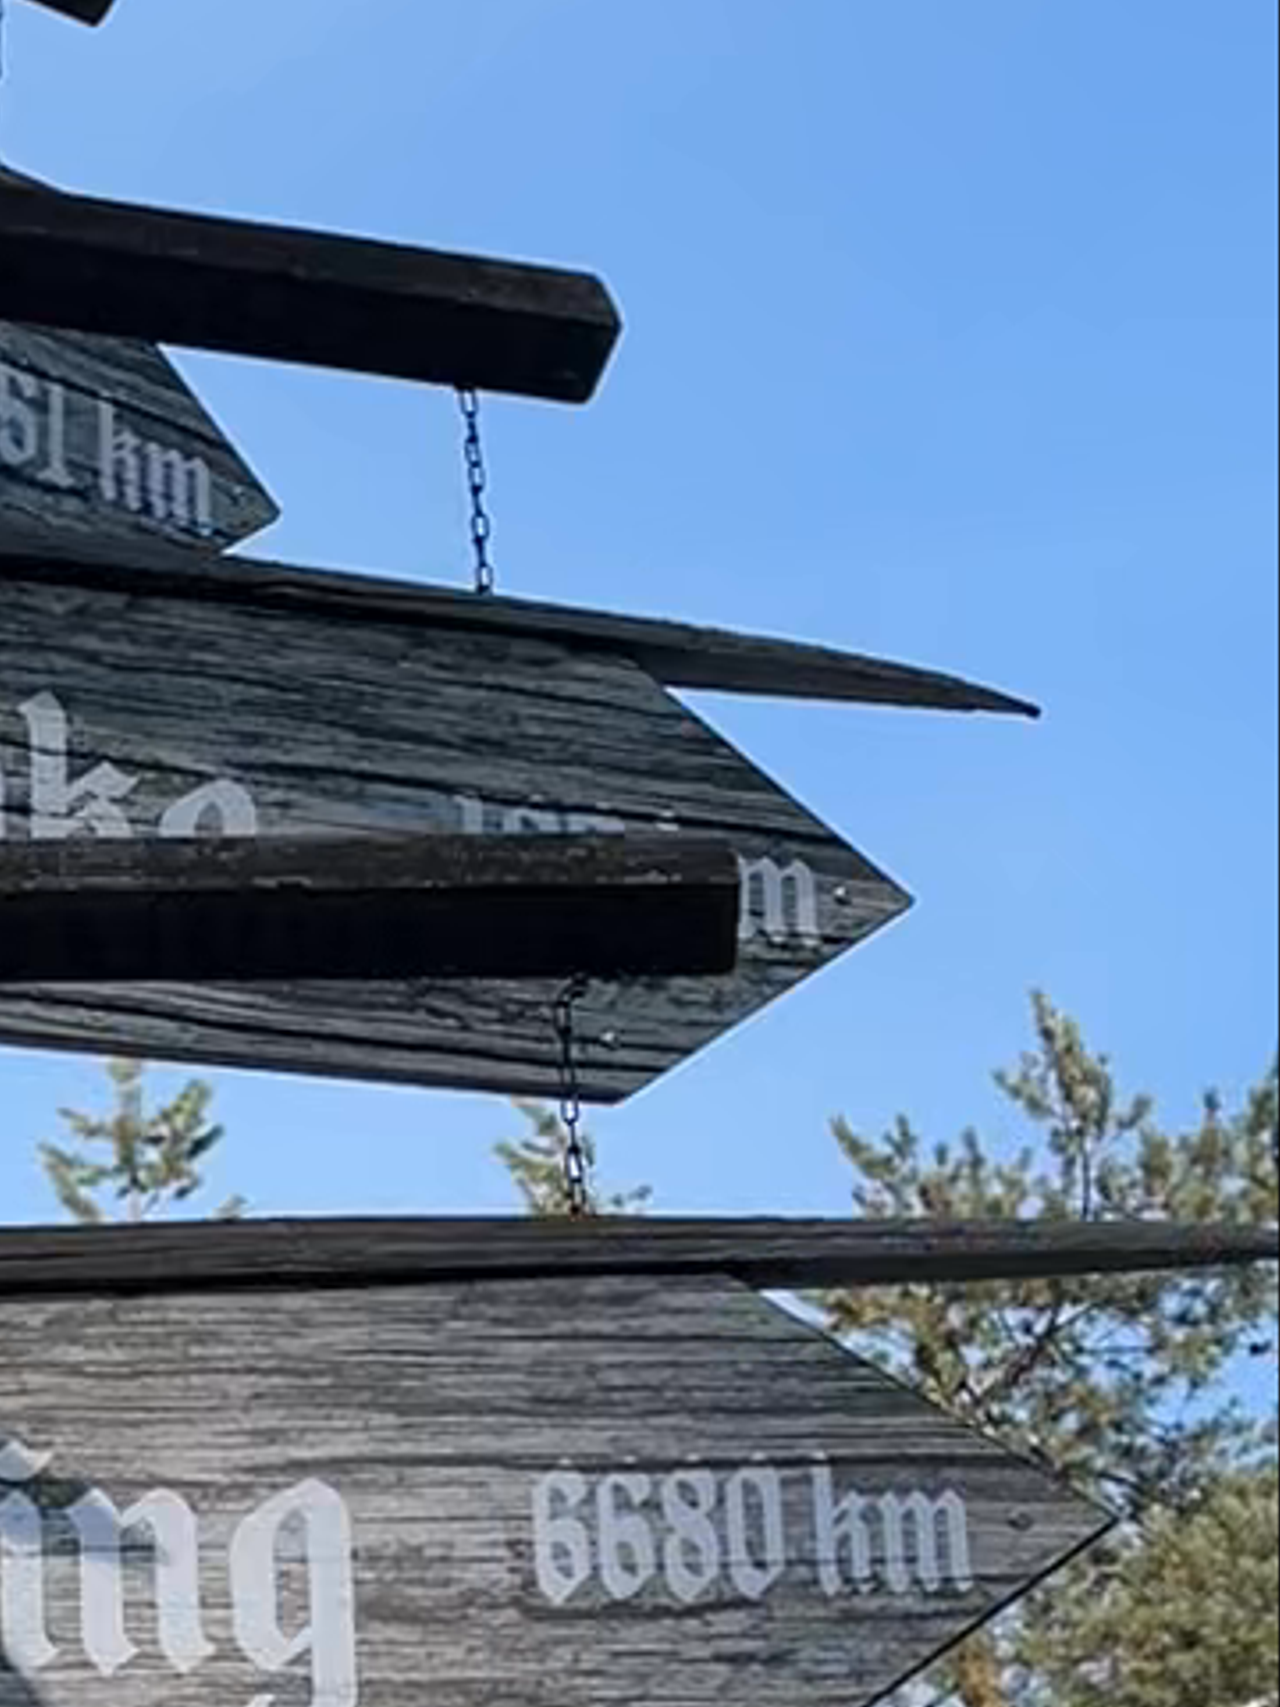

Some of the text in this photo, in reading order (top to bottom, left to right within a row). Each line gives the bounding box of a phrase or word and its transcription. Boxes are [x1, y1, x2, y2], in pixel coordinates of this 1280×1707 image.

[95, 391, 210, 536] km
[532, 1456, 786, 1606] 6680
[809, 1451, 973, 1597] km
